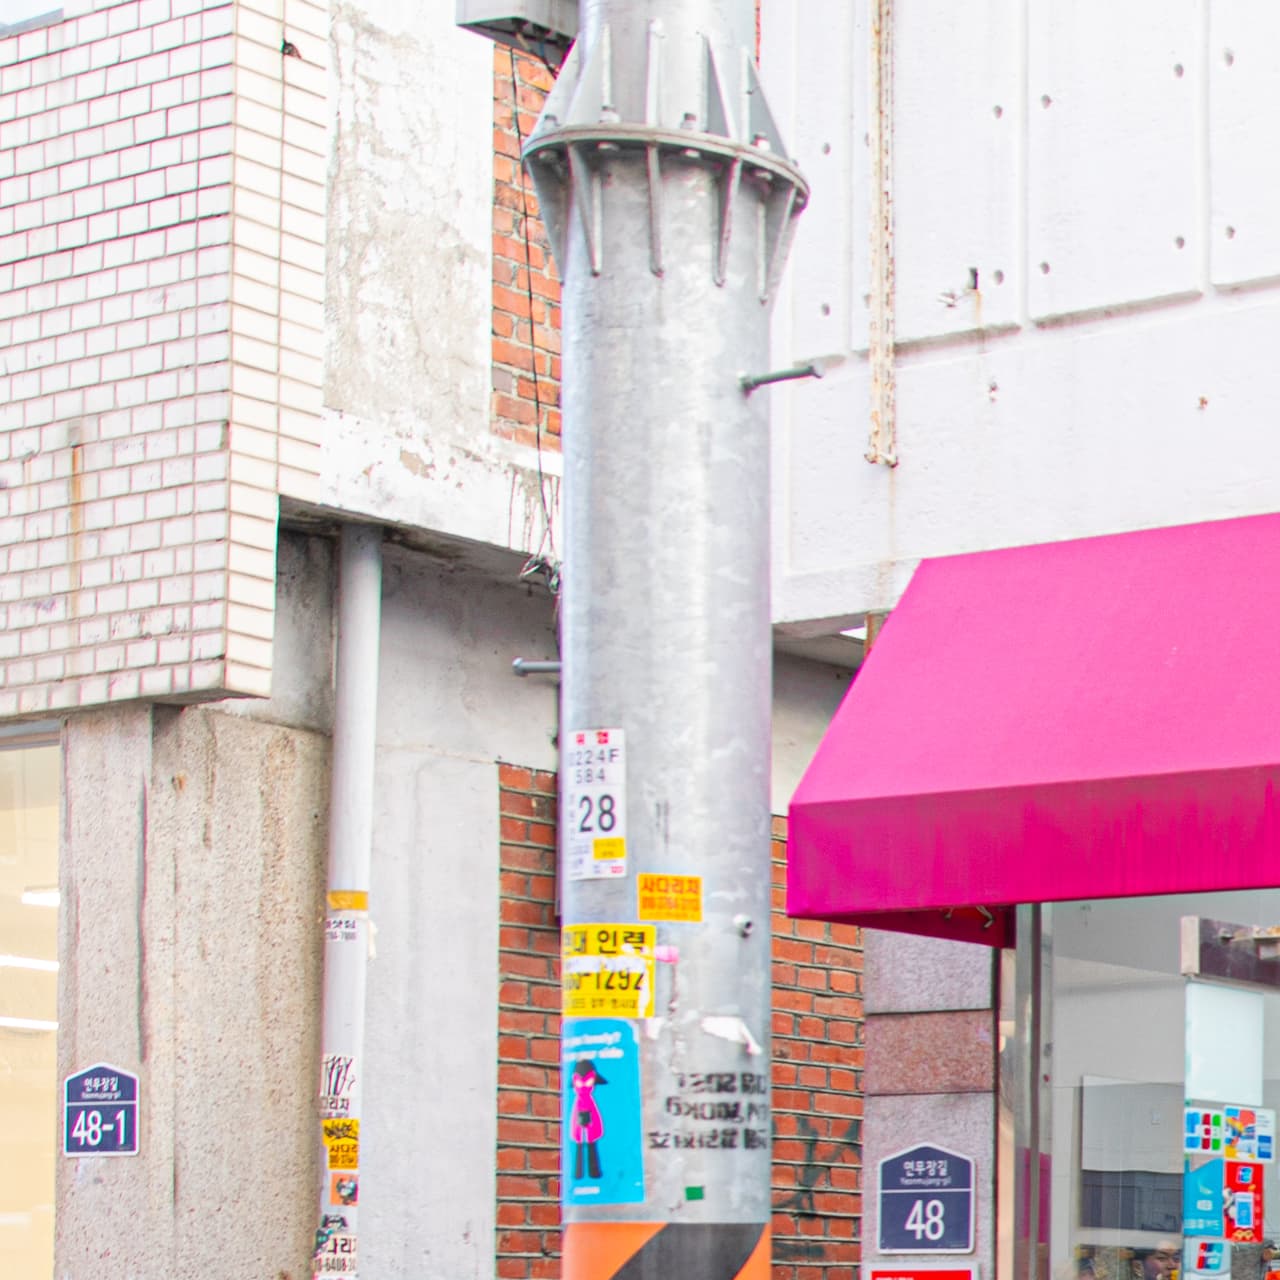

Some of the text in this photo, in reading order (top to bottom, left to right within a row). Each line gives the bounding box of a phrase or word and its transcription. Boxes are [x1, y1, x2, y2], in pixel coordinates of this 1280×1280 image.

[578, 793, 616, 832] 28
[71, 1109, 126, 1146] 48-1
[903, 1159, 948, 1177] 연무장길
[904, 1199, 945, 1241] 48
